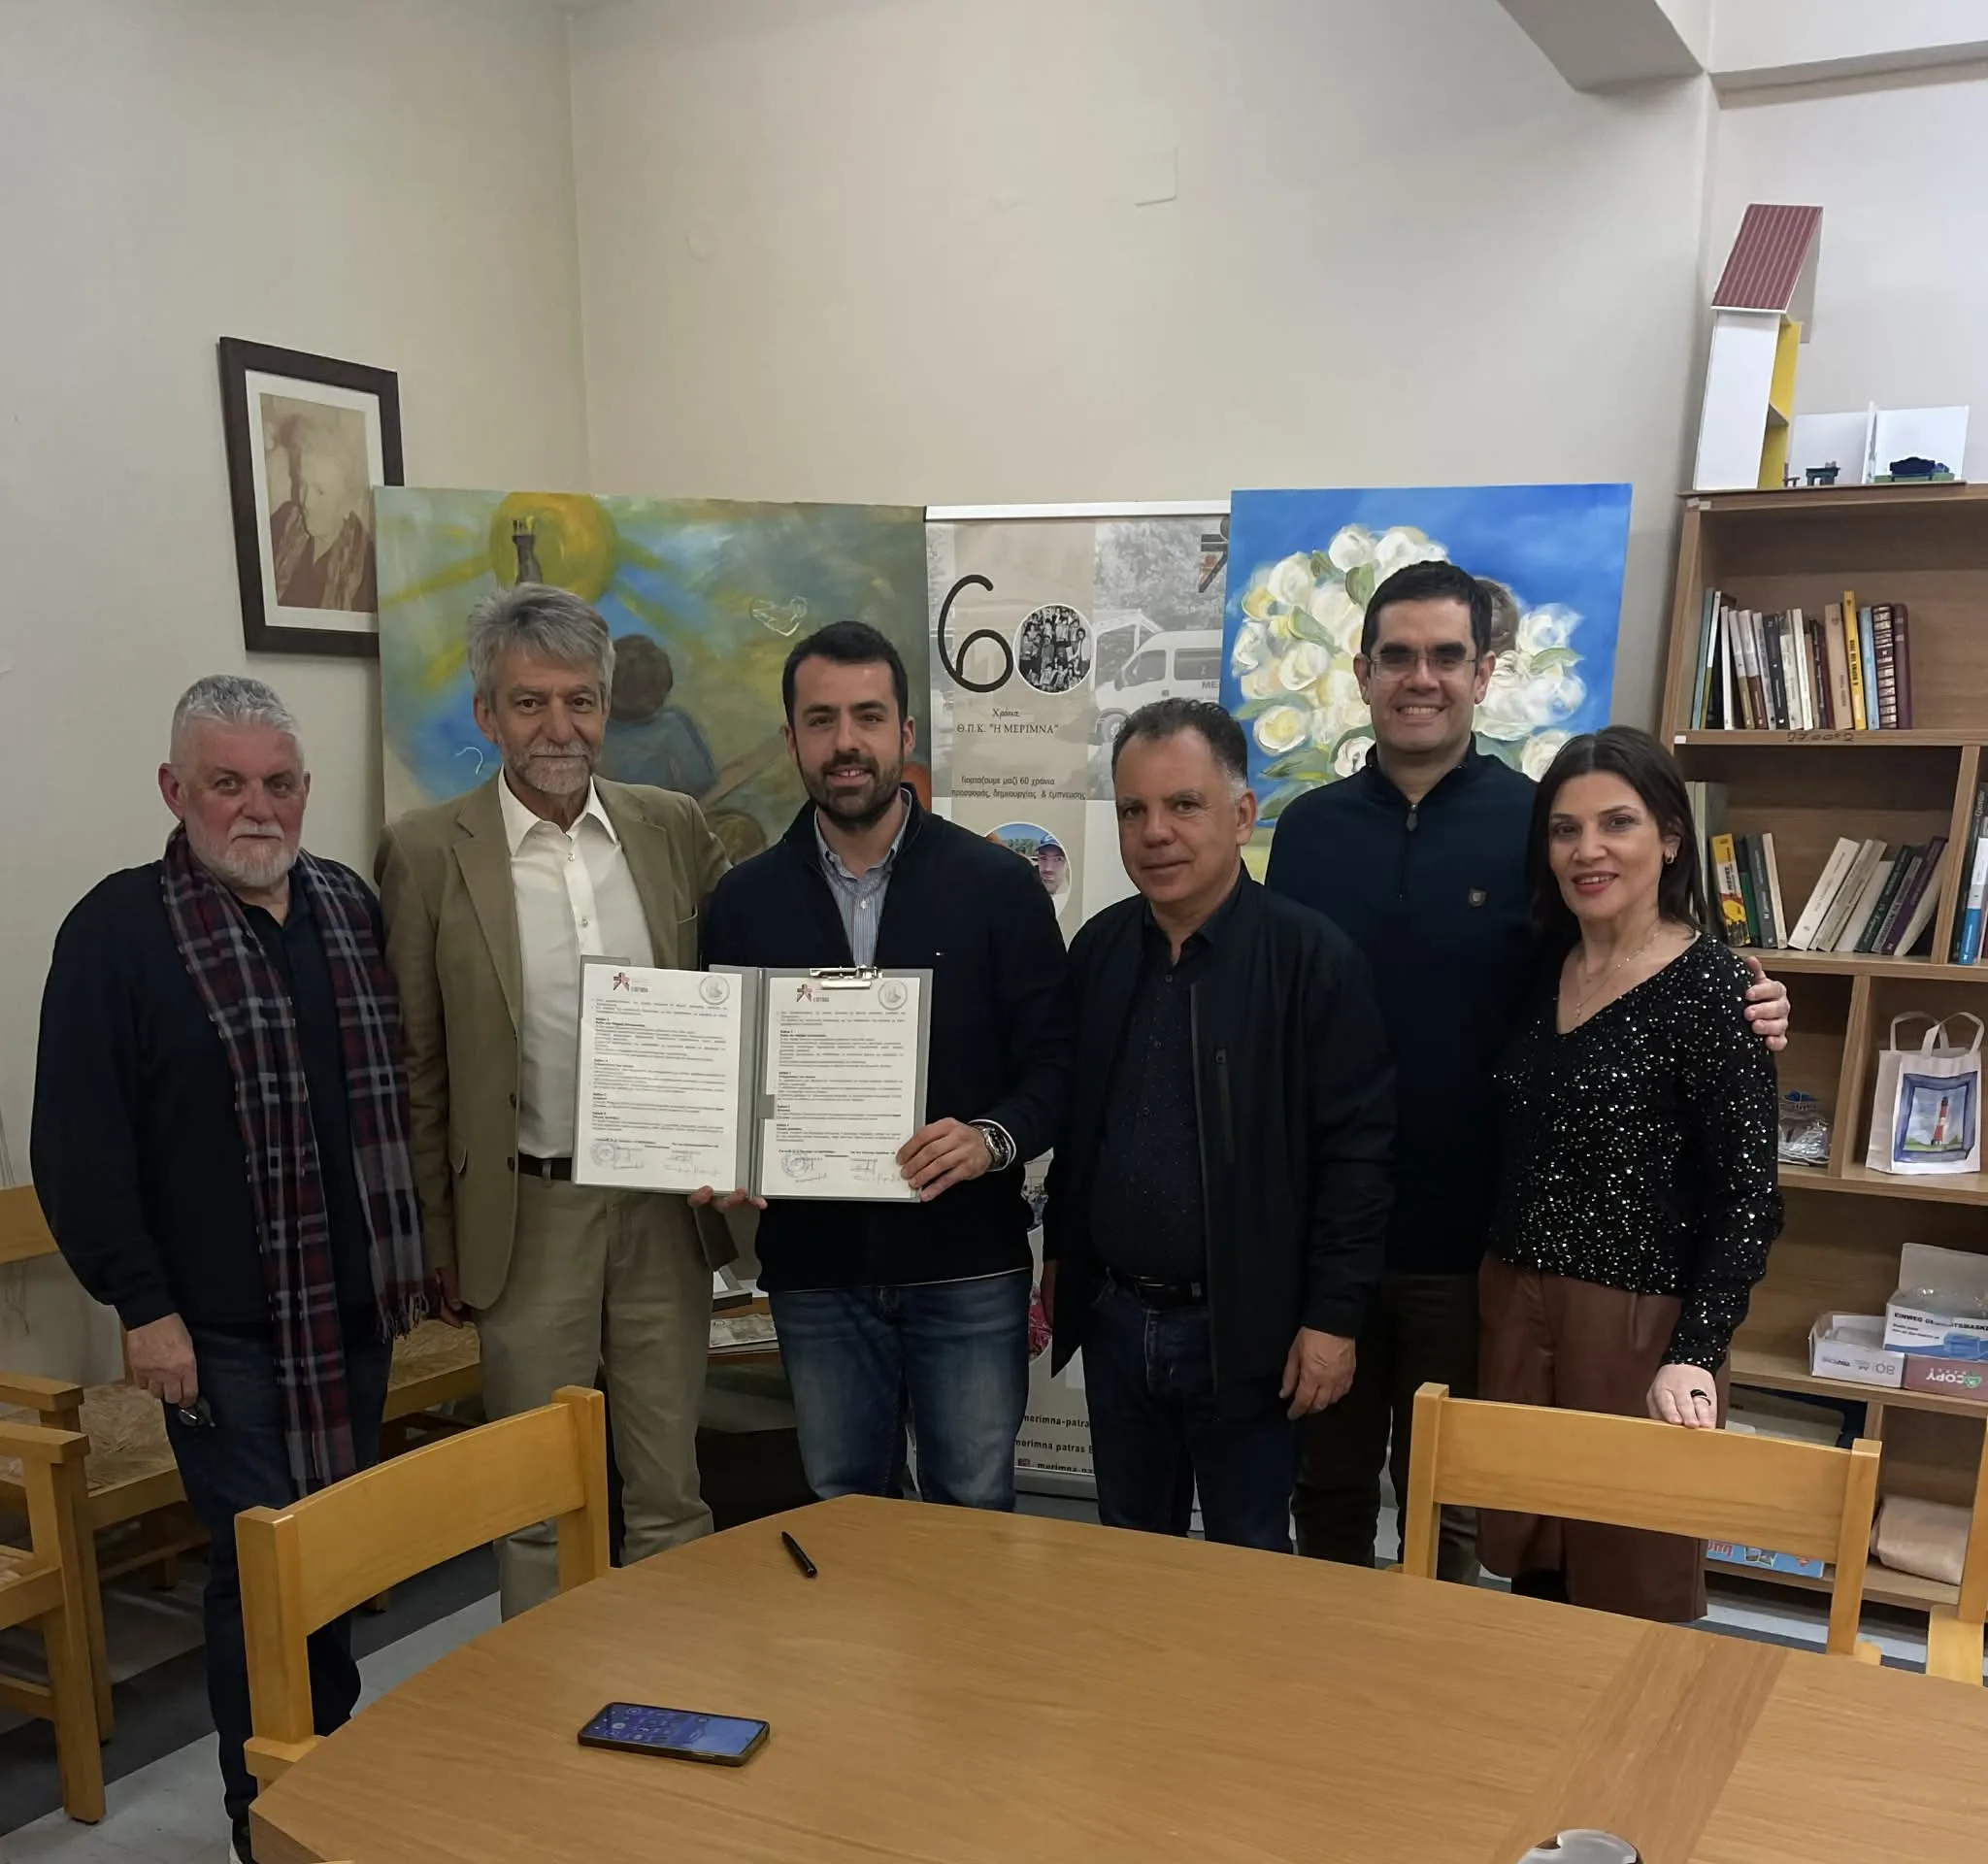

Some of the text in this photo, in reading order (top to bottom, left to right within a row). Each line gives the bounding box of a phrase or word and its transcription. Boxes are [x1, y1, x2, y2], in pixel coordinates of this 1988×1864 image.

[956, 723, 986, 733] Θ.Π.Κ.
[1004, 724, 1059, 735] ΜΕΡΙΜΝΑ"
[1003, 777, 1017, 785] μαζί
[1031, 778, 1055, 786] χρόνια
[1056, 1444, 1085, 1453] patras
